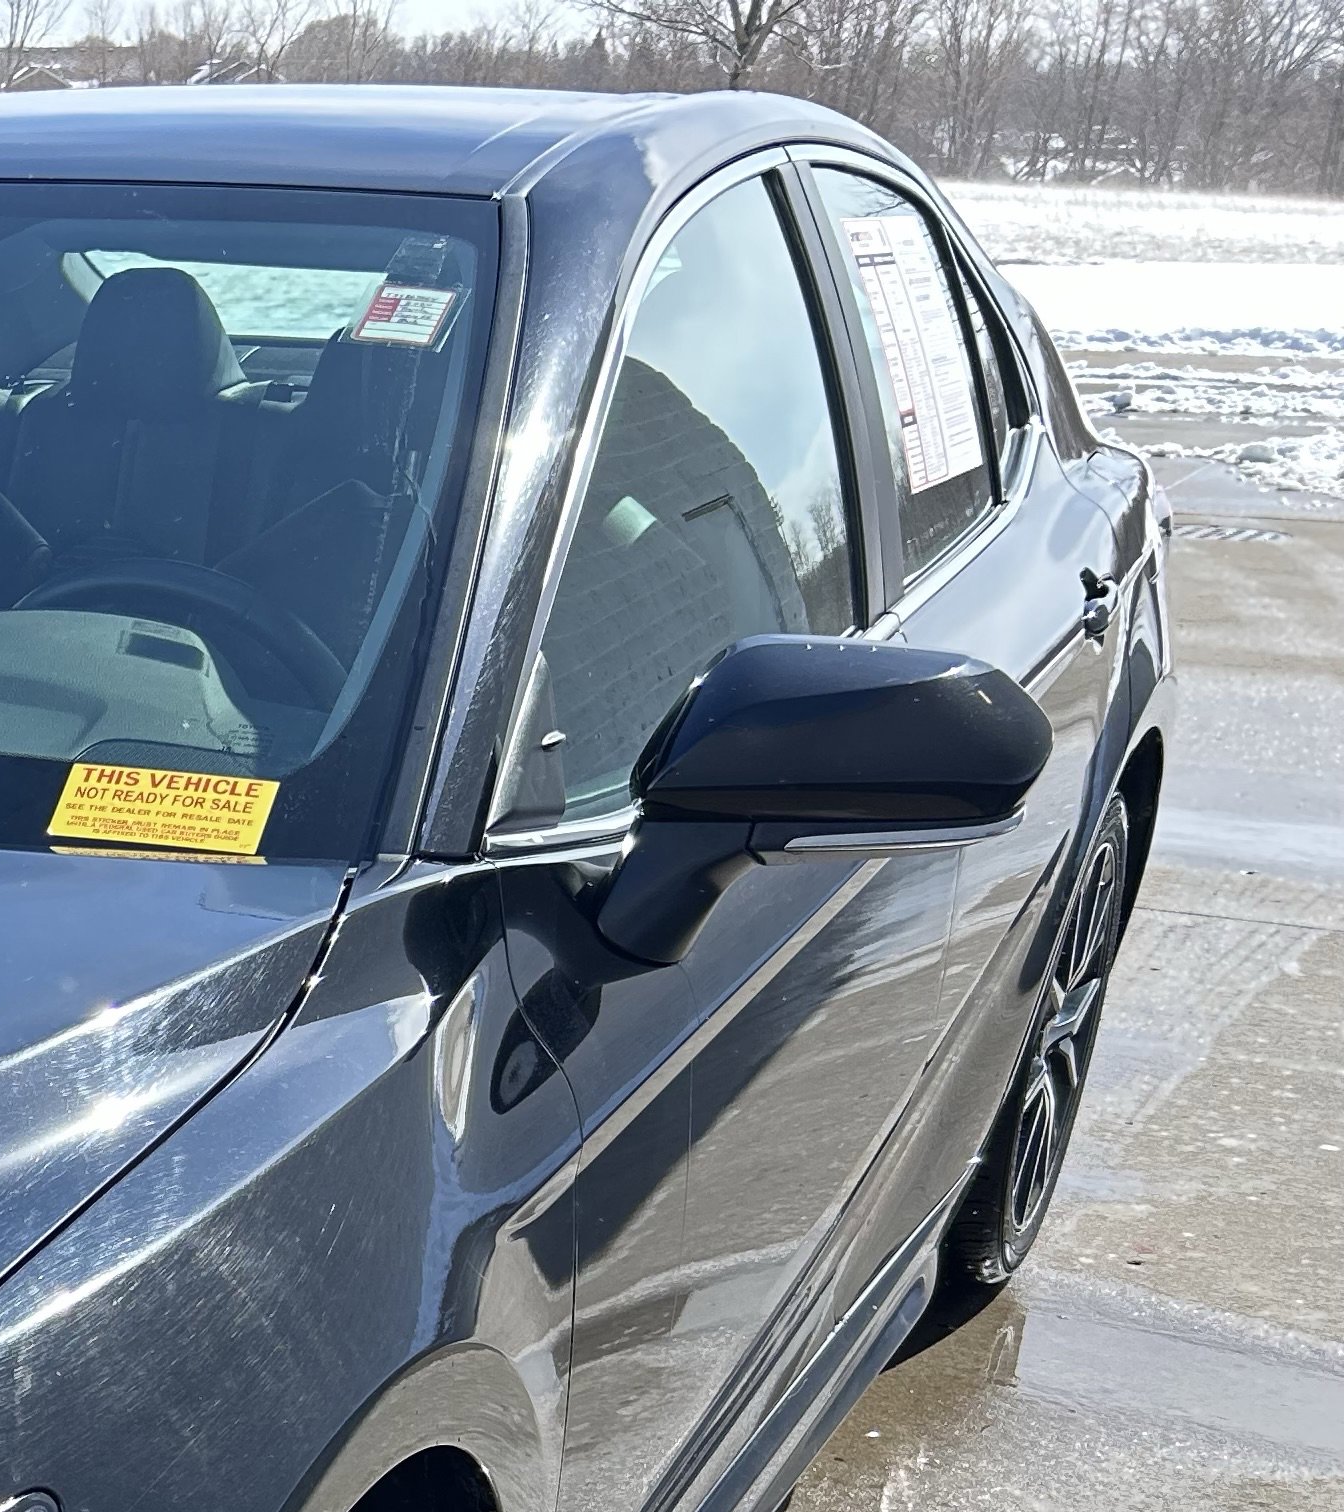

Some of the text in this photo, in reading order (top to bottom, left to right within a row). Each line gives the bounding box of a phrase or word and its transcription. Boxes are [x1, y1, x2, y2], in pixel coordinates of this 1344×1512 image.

[82, 767, 263, 798] THIS VEHICLE
[74, 786, 254, 814] NOT READY FOR SALE
[89, 805, 108, 813] THE
[112, 807, 151, 817] DEALER
[156, 810, 177, 818] FOR
[181, 813, 221, 823] RESALE
[227, 817, 254, 826] DATE
[92, 817, 128, 825] STICKER
[161, 823, 196, 831] REMAIN
[211, 828, 240, 836] PLACE
